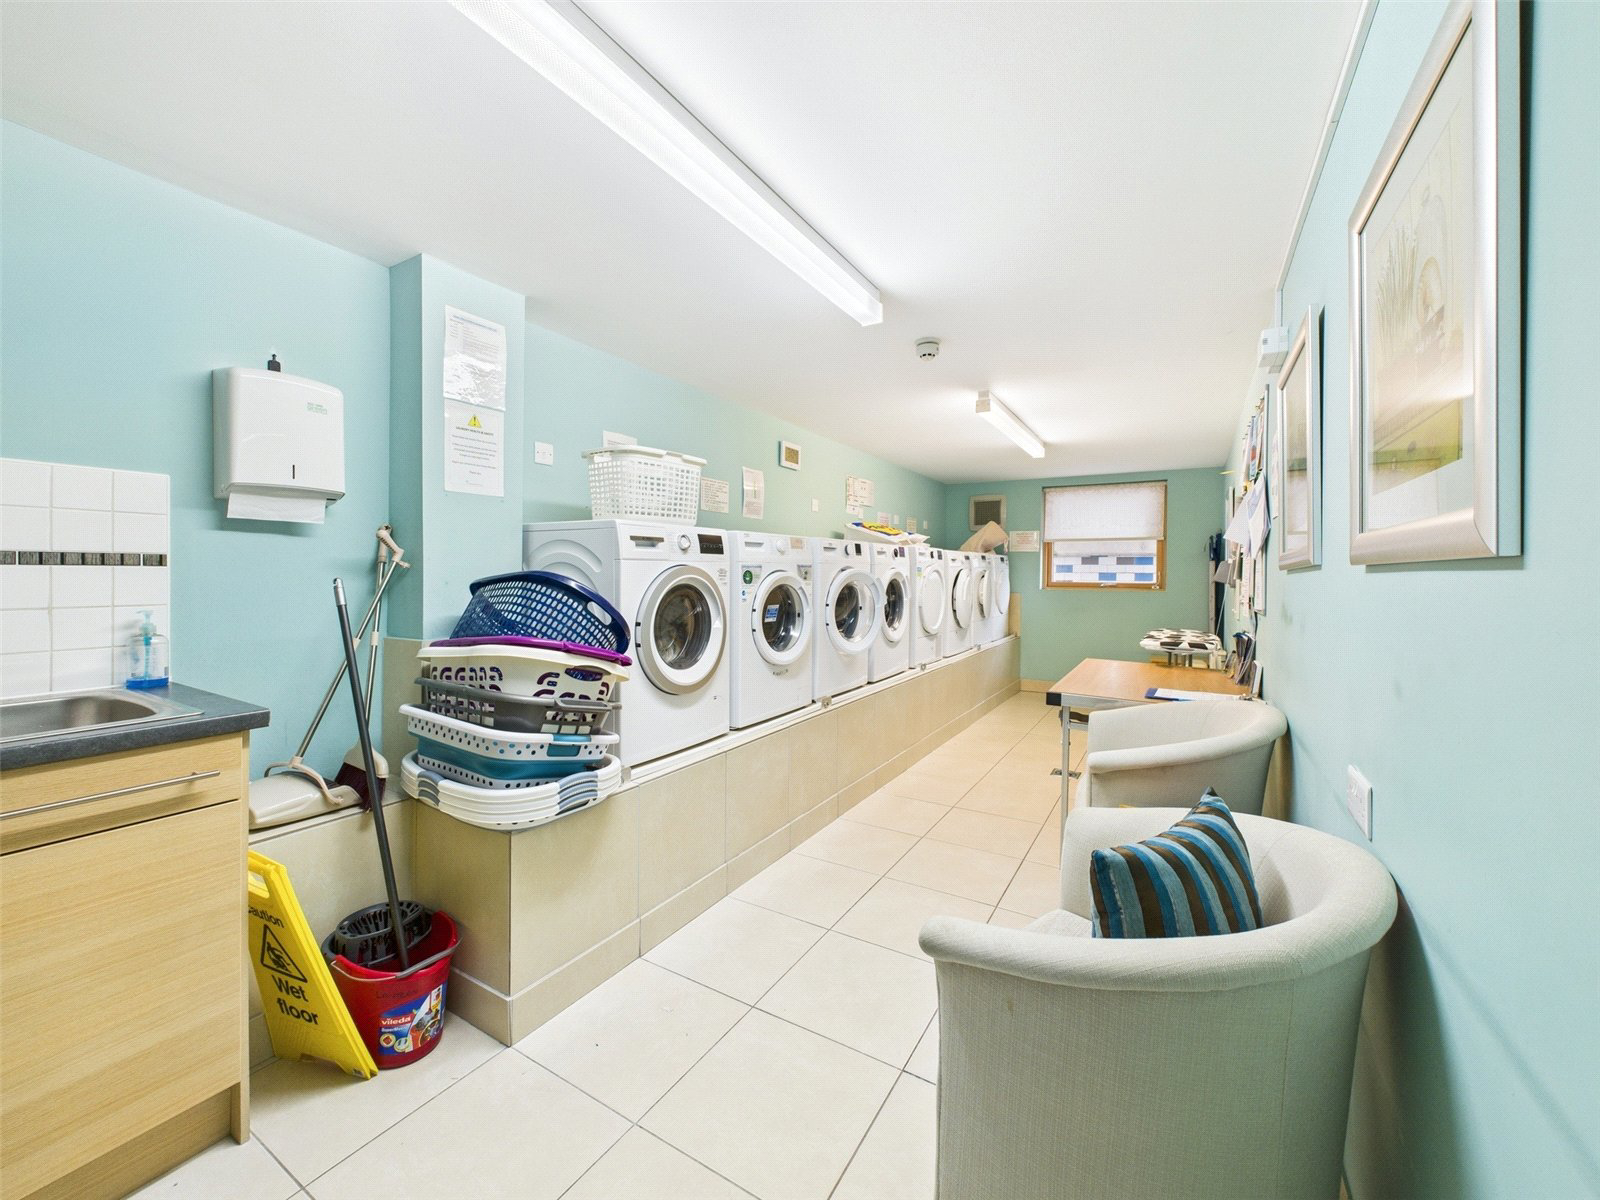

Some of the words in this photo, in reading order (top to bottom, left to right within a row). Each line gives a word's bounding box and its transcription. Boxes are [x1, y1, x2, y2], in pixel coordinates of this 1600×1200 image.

[248, 905, 284, 928] aution
[271, 974, 309, 1002] Wet
[276, 997, 319, 1025] floor
[381, 1016, 411, 1025] vileda
